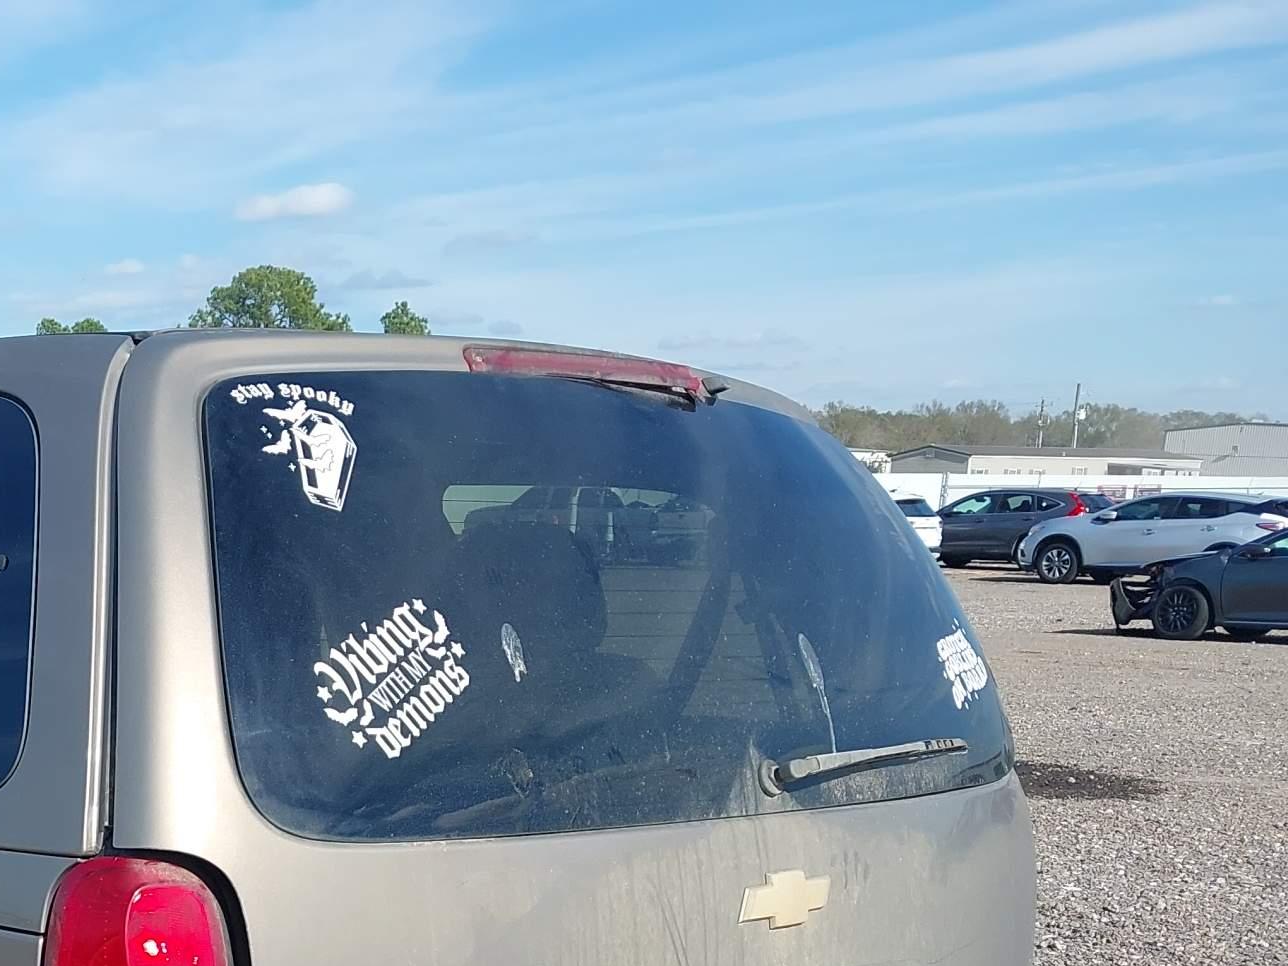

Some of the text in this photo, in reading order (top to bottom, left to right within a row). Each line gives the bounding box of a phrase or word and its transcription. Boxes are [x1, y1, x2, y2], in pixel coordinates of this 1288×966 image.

[229, 382, 355, 416] stay spooky
[313, 601, 433, 706] Vibing
[367, 647, 433, 713] WITH MY
[365, 651, 470, 759] demons
